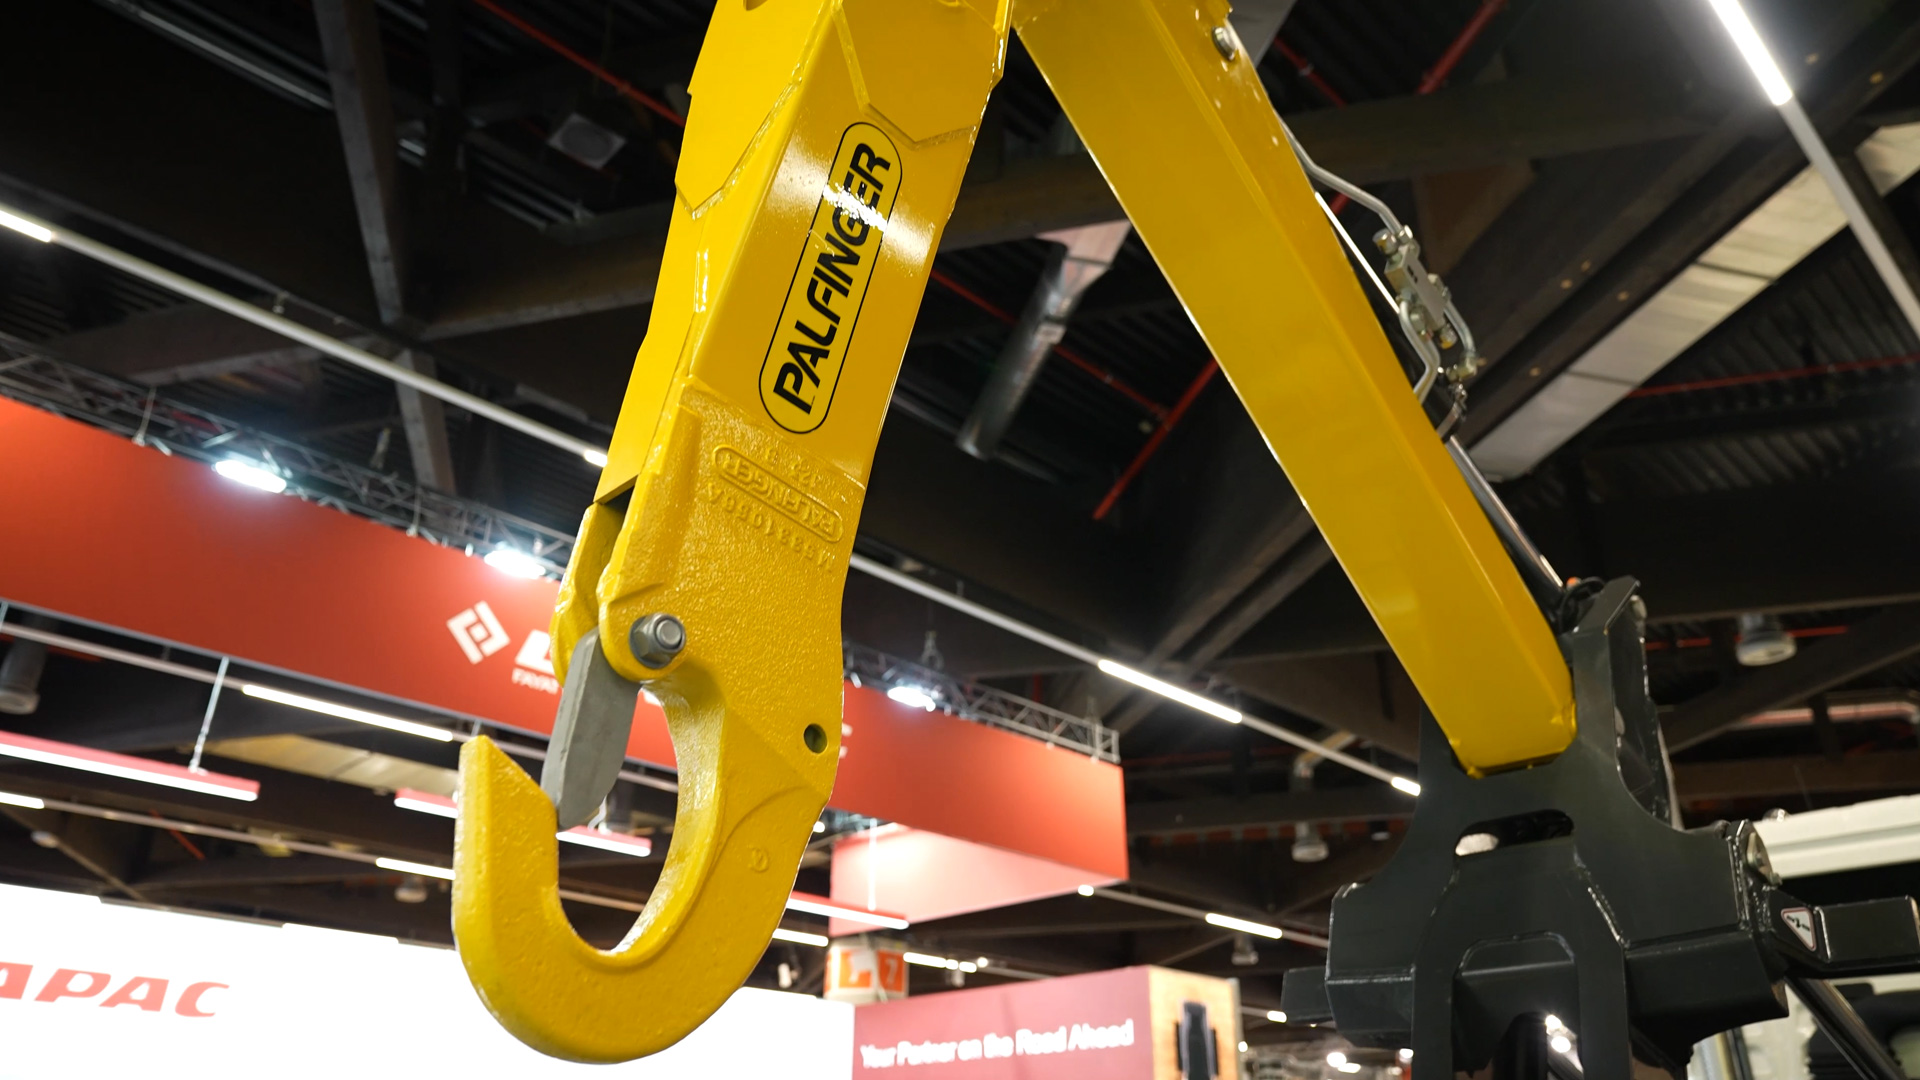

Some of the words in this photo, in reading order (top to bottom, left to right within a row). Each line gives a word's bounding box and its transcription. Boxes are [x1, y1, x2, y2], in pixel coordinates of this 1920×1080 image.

[773, 142, 891, 415] PALFINGER
[722, 453, 837, 537] PALFINGER
[860, 1044, 898, 1068] Your
[897, 1040, 958, 1066] Partner
[957, 1038, 983, 1060] on
[984, 1032, 1014, 1058] the
[1016, 1026, 1067, 1055] Road
[1068, 1018, 1134, 1051] Ahead
